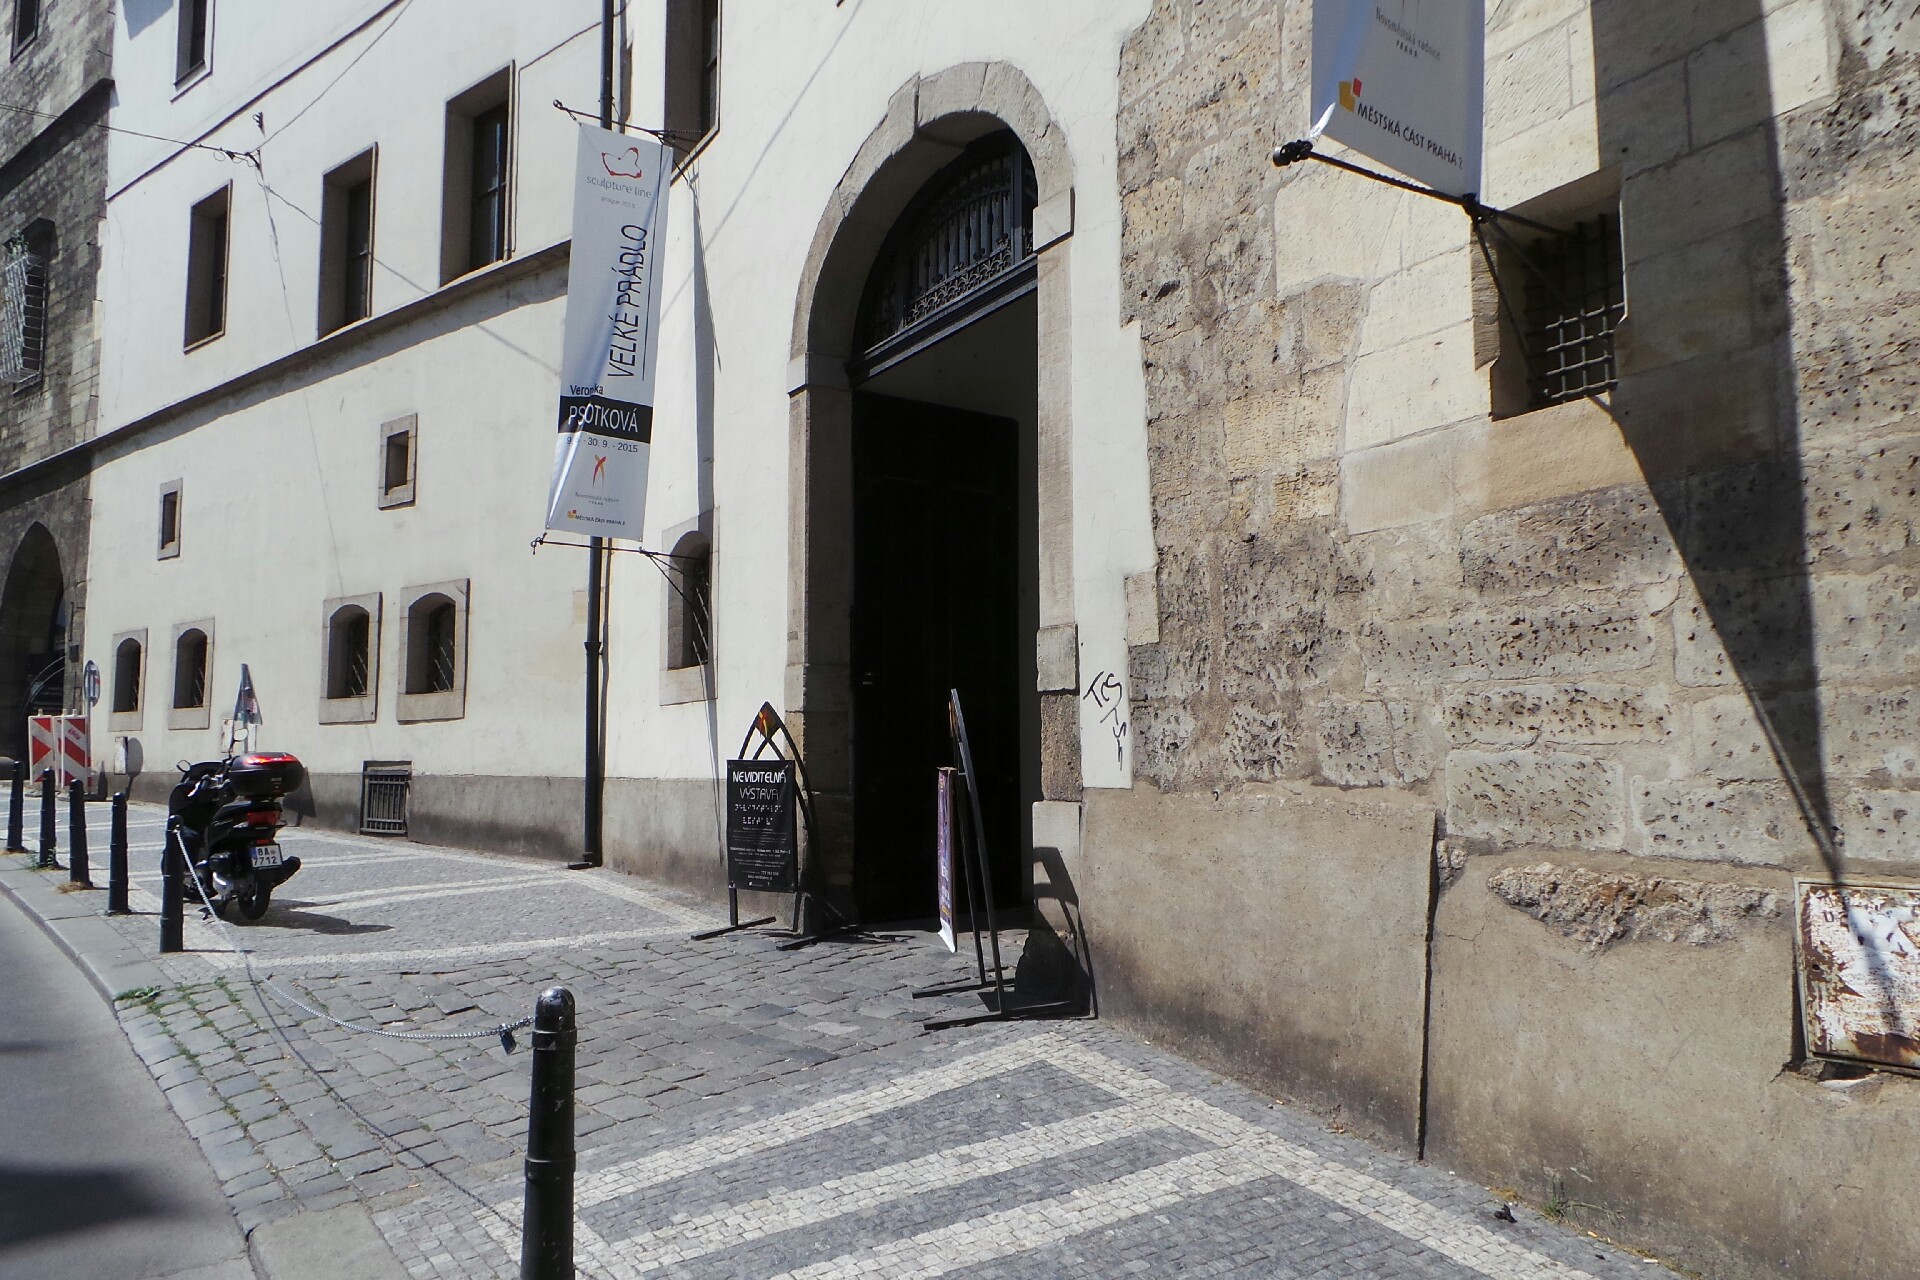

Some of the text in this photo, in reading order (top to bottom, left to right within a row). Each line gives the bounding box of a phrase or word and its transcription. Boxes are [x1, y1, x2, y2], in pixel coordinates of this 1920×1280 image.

[1357, 102, 1401, 137] MĚSTSKÁ
[1427, 140, 1457, 167] PRAHA
[586, 175, 652, 199] sculpture line
[607, 224, 649, 378] VELKÉ PRÁDLO
[569, 383, 604, 396] Veronka
[568, 402, 639, 433] PSOTKOVÁ
[588, 436, 600, 448] 30.
[602, 439, 610, 449] 9.
[617, 442, 639, 453] 2015
[732, 769, 787, 784] NEVIDITELNÁ
[739, 785, 779, 801] VÝSTAVA
